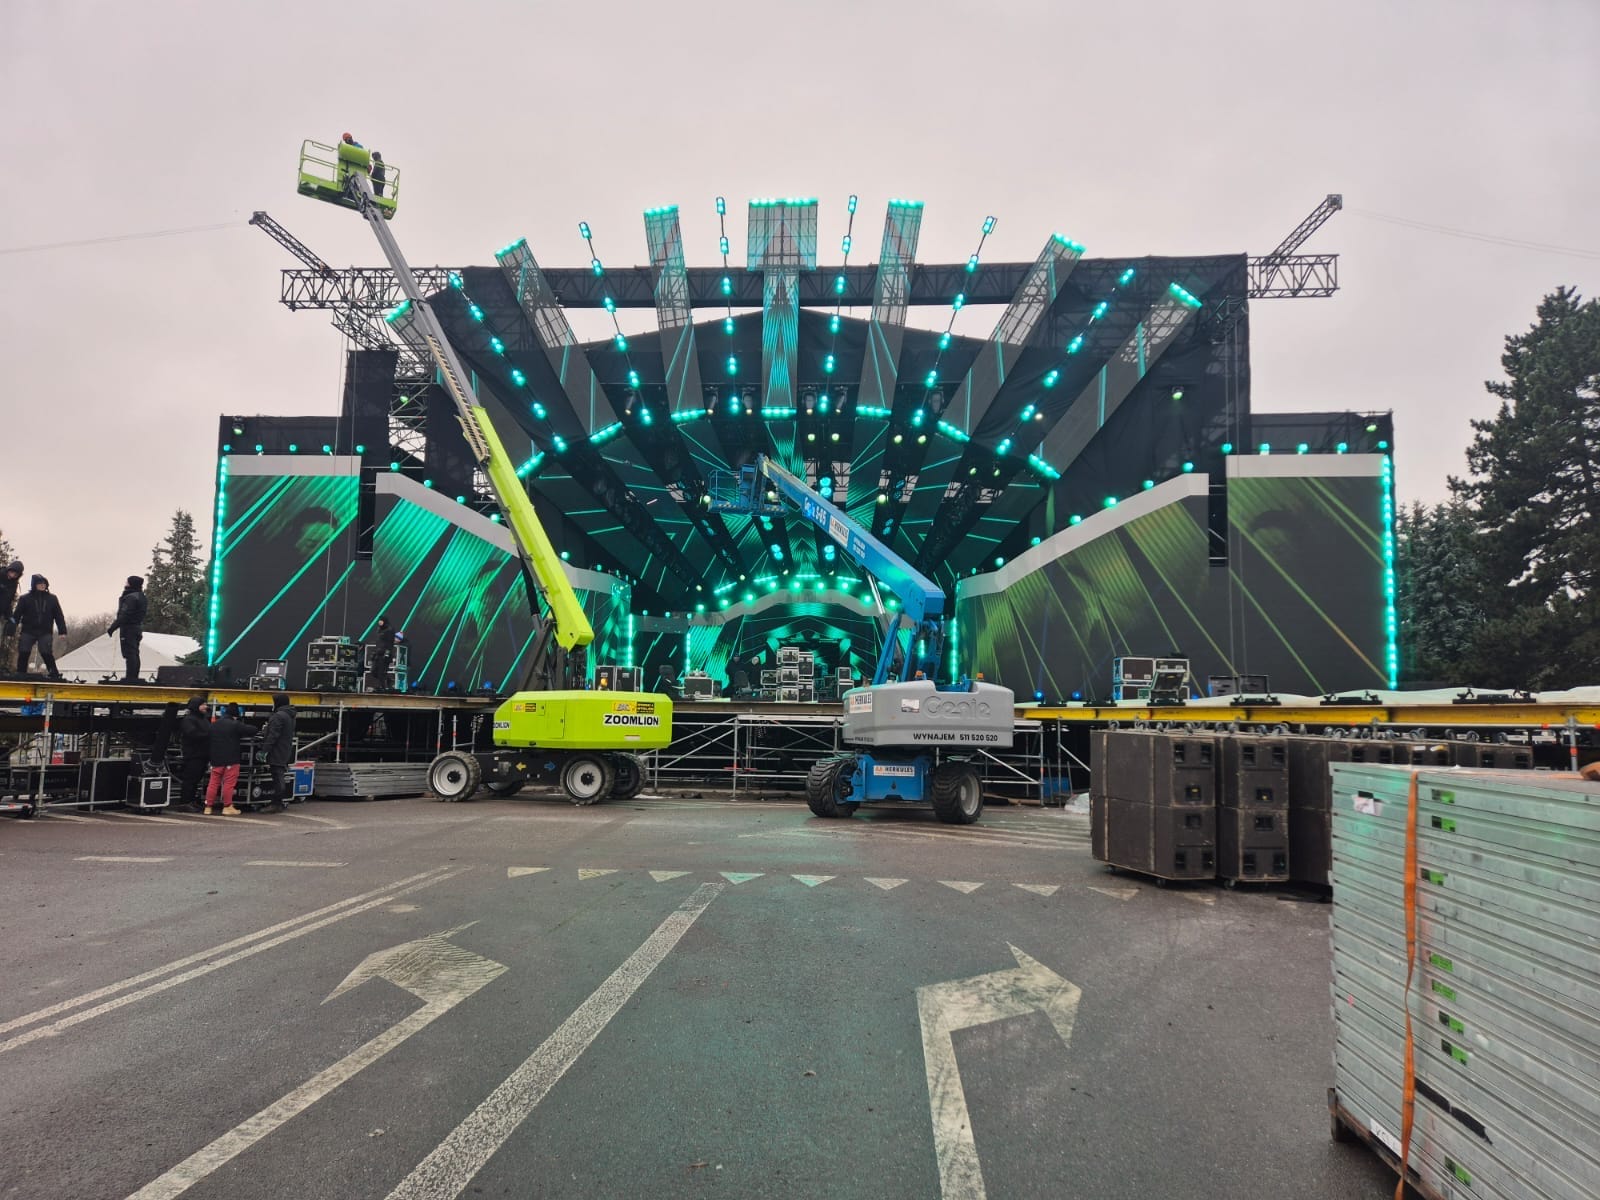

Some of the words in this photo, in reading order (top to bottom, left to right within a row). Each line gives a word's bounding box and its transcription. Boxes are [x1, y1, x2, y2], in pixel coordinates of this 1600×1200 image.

[923, 695, 992, 720] Genie
[605, 714, 659, 726] ZOOMLION
[913, 733, 955, 741] WYNAJEM
[985, 734, 998, 742] 520
